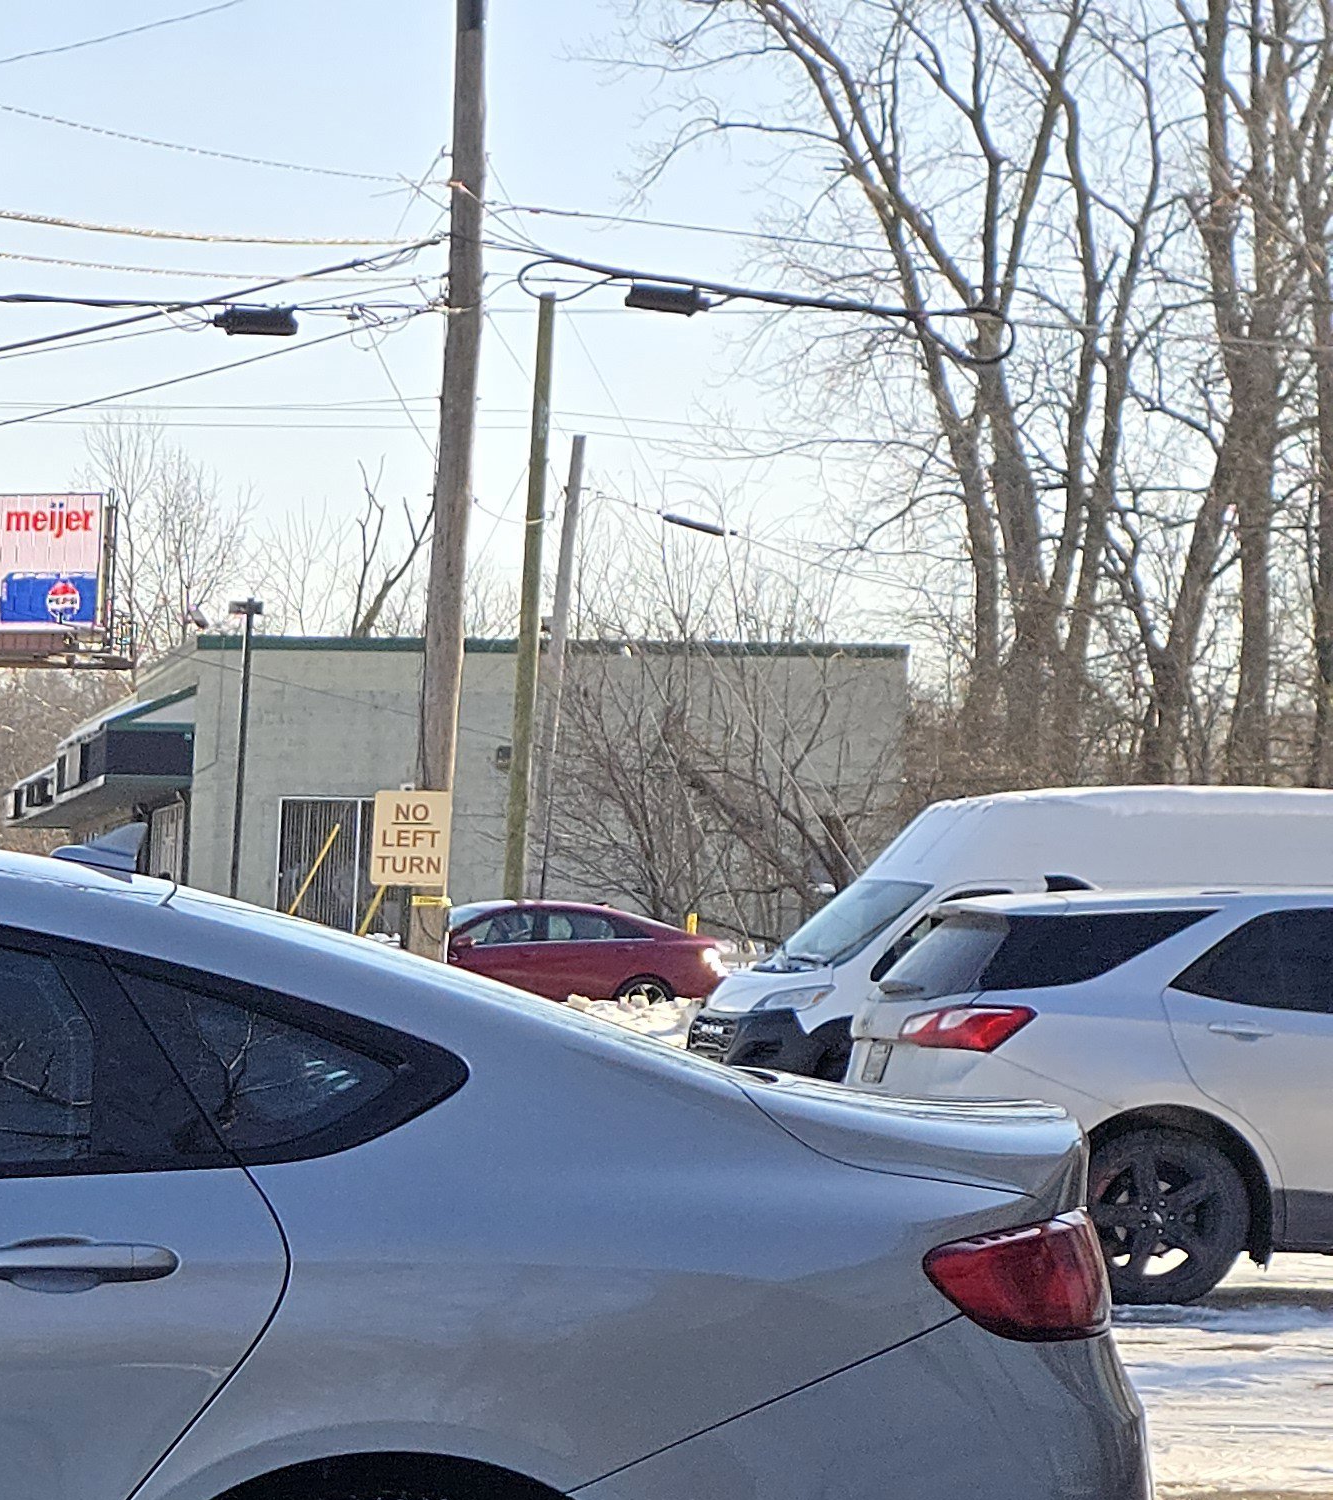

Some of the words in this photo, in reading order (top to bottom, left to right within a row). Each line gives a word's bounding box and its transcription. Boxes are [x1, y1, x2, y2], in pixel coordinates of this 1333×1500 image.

[6, 502, 95, 538] meijer
[395, 803, 430, 821] NO
[381, 829, 441, 848] LEFT
[376, 855, 441, 874] TURN
